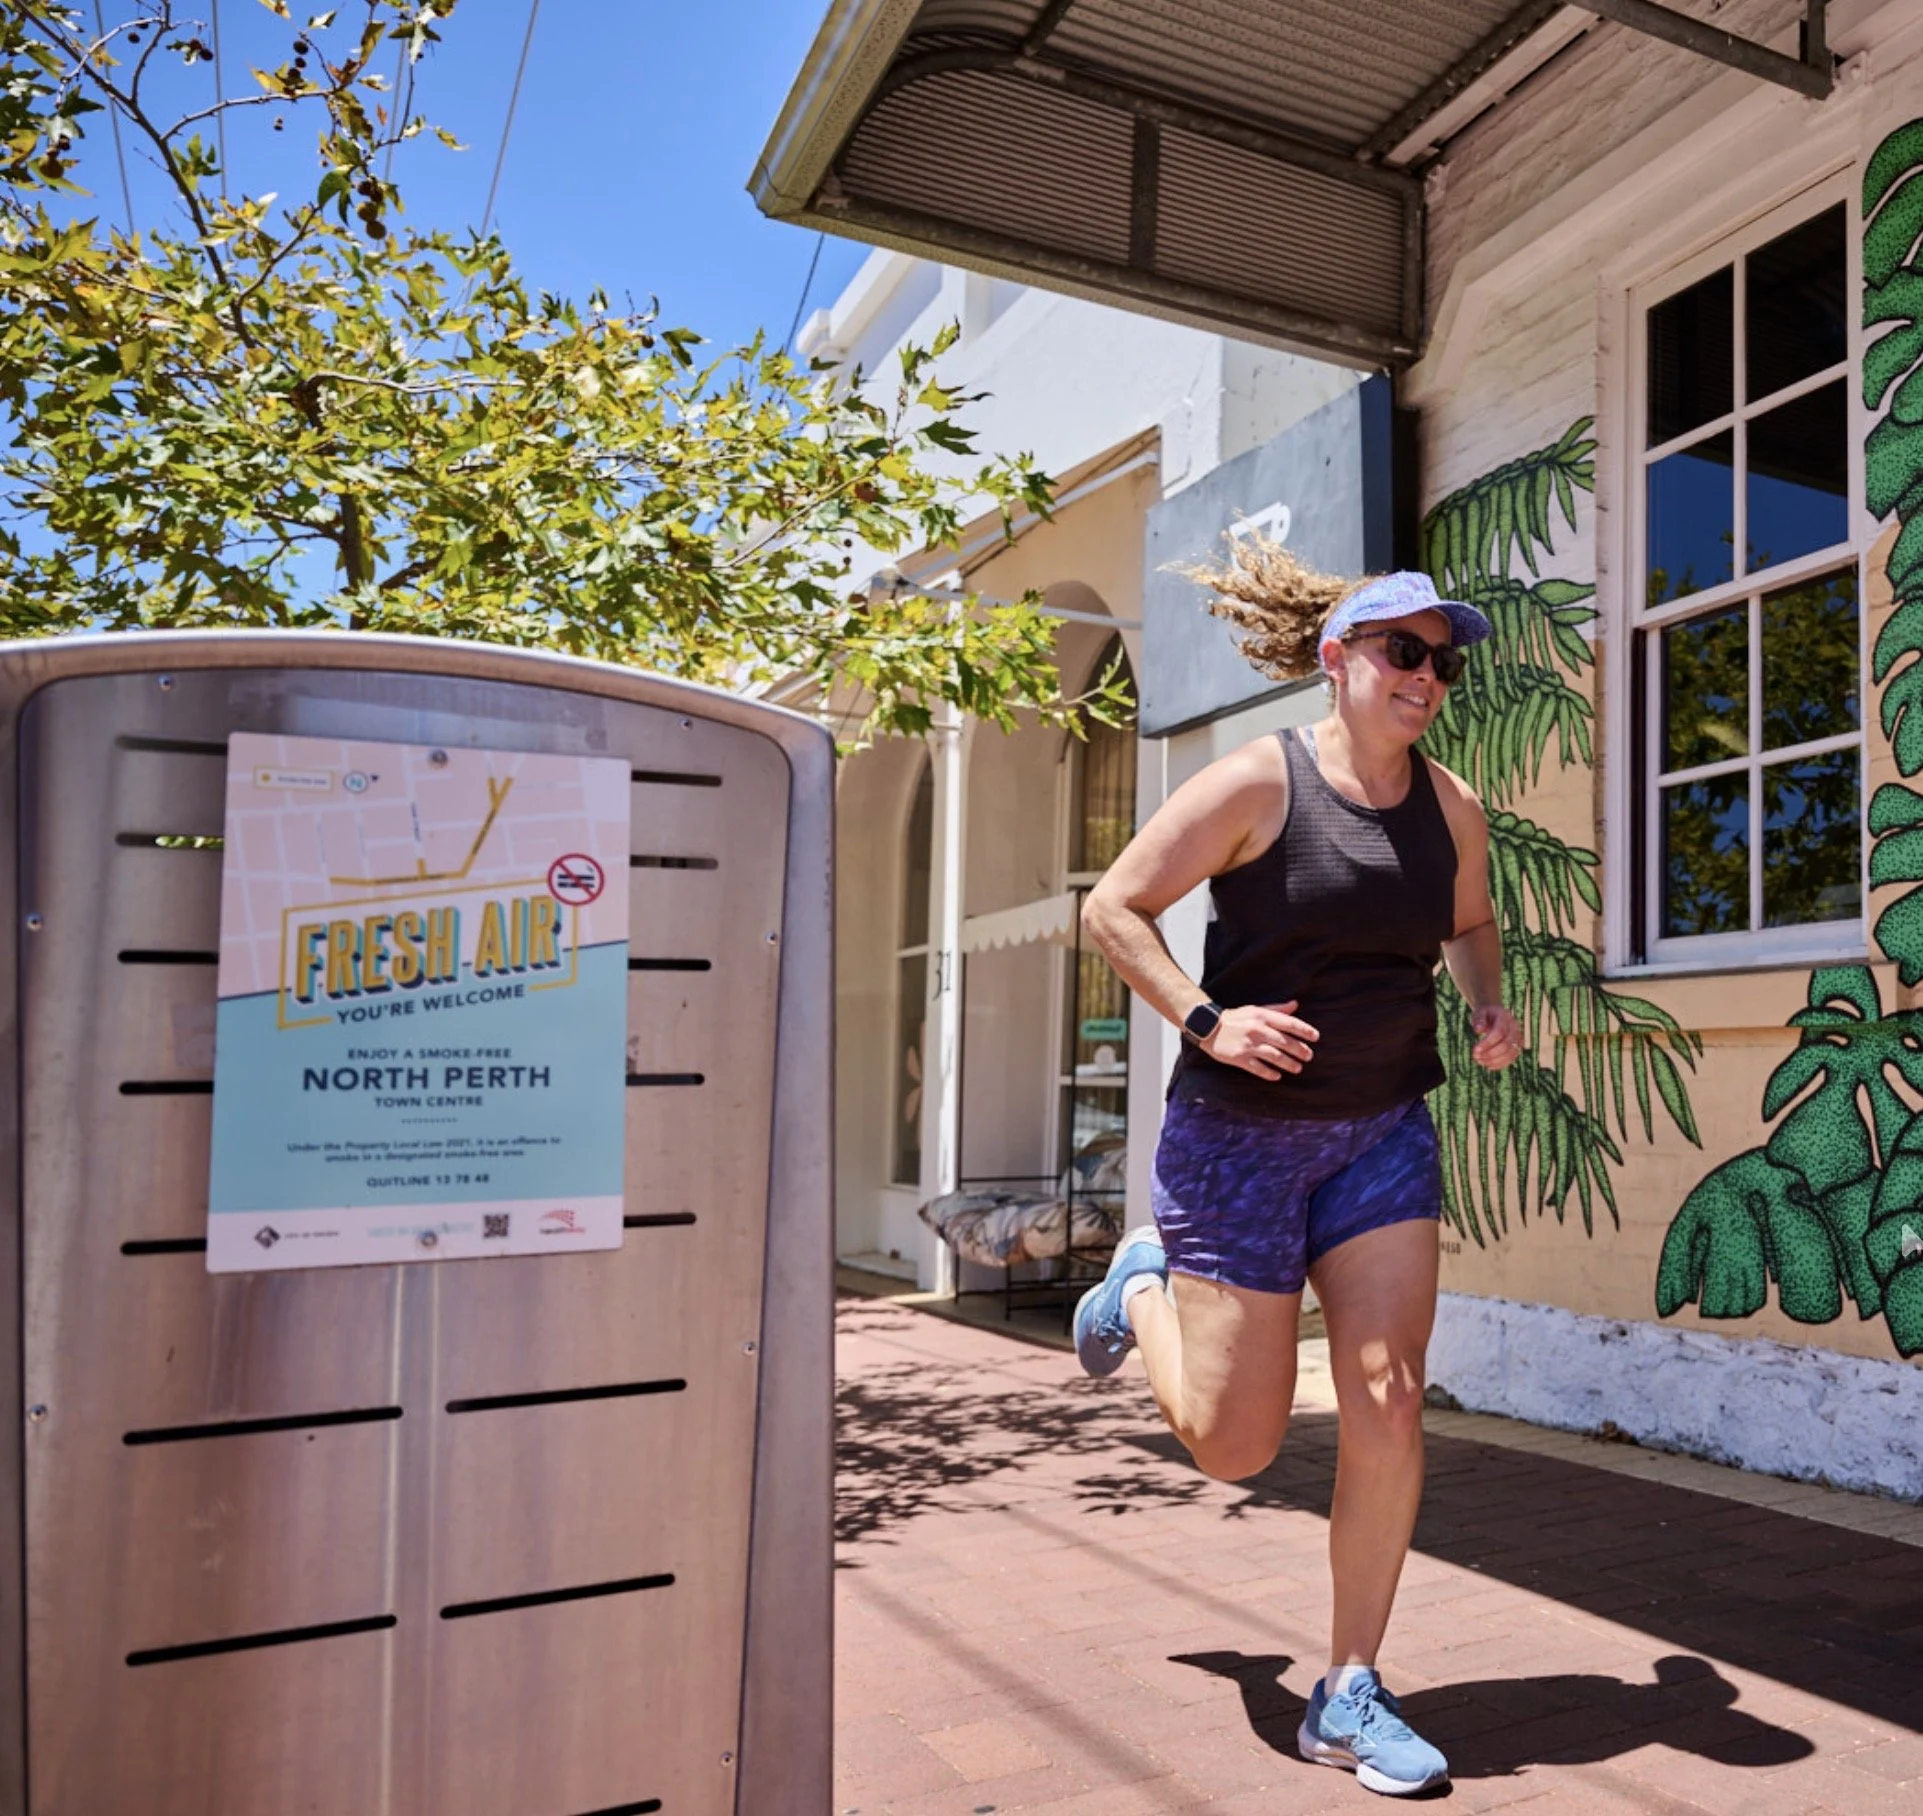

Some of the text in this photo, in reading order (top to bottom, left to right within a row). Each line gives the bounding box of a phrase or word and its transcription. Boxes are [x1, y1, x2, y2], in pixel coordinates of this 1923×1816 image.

[294, 894, 563, 1004] FRESH AIR
[336, 983, 526, 1025] YOU'RE WELCOME
[347, 1047, 513, 1060] ENJOY A SMOKE-FREE
[303, 1065, 552, 1092] NORTH PERTH
[375, 1095, 484, 1108] TOWN CENTRE
[287, 1142, 321, 1153] Under
[366, 1172, 491, 1189] QUITLINE 13 78 48
